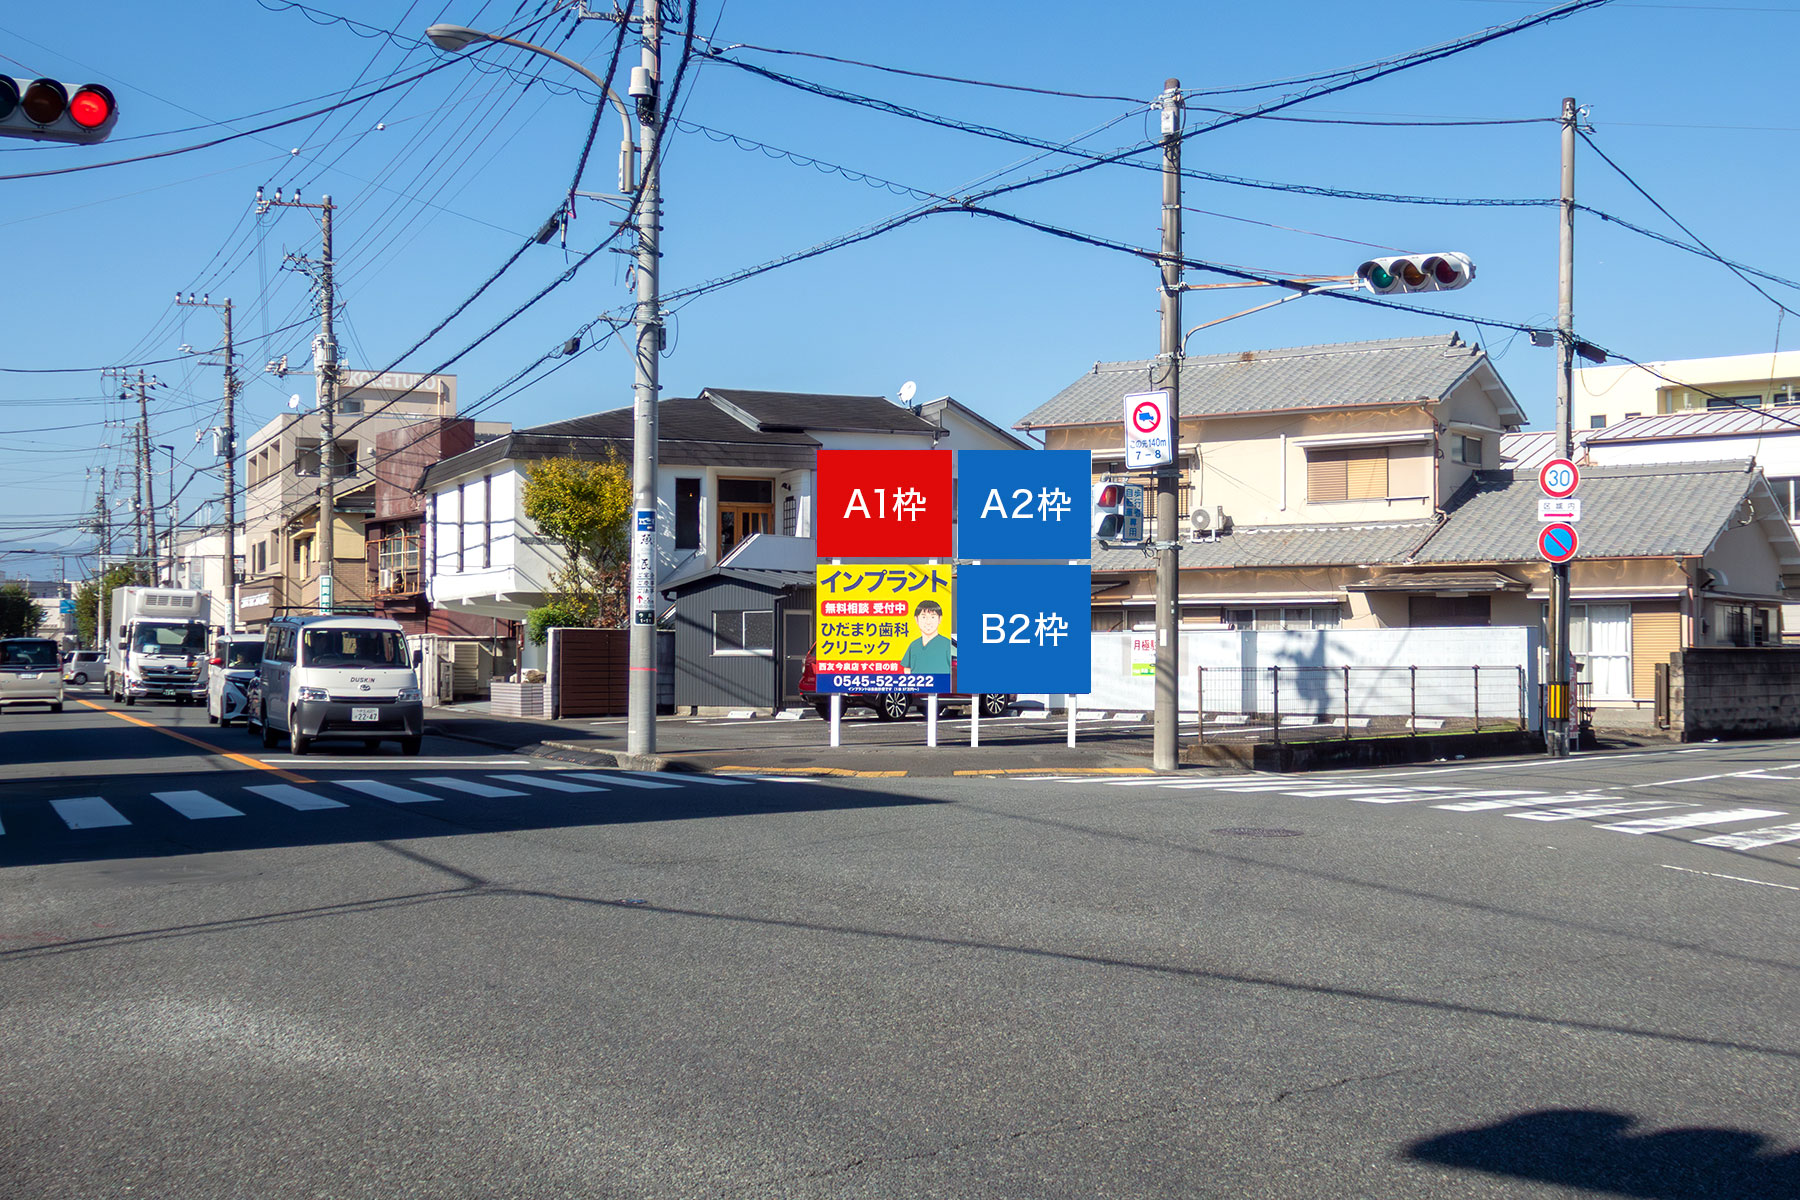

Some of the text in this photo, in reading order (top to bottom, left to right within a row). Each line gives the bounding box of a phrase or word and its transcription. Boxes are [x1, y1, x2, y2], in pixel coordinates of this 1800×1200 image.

[1548, 469, 1571, 487] 30
[843, 487, 927, 522] A1枠
[980, 487, 1071, 522] A2枠
[1543, 502, 1576, 511] 区域内
[821, 569, 948, 593] インプラント
[825, 602, 906, 614] 無料相談 受付中
[821, 622, 909, 637] ひだまり歯科
[982, 611, 1069, 647] B2枠
[821, 640, 890, 655] クリニック
[833, 675, 934, 687] 0545-52-2222
